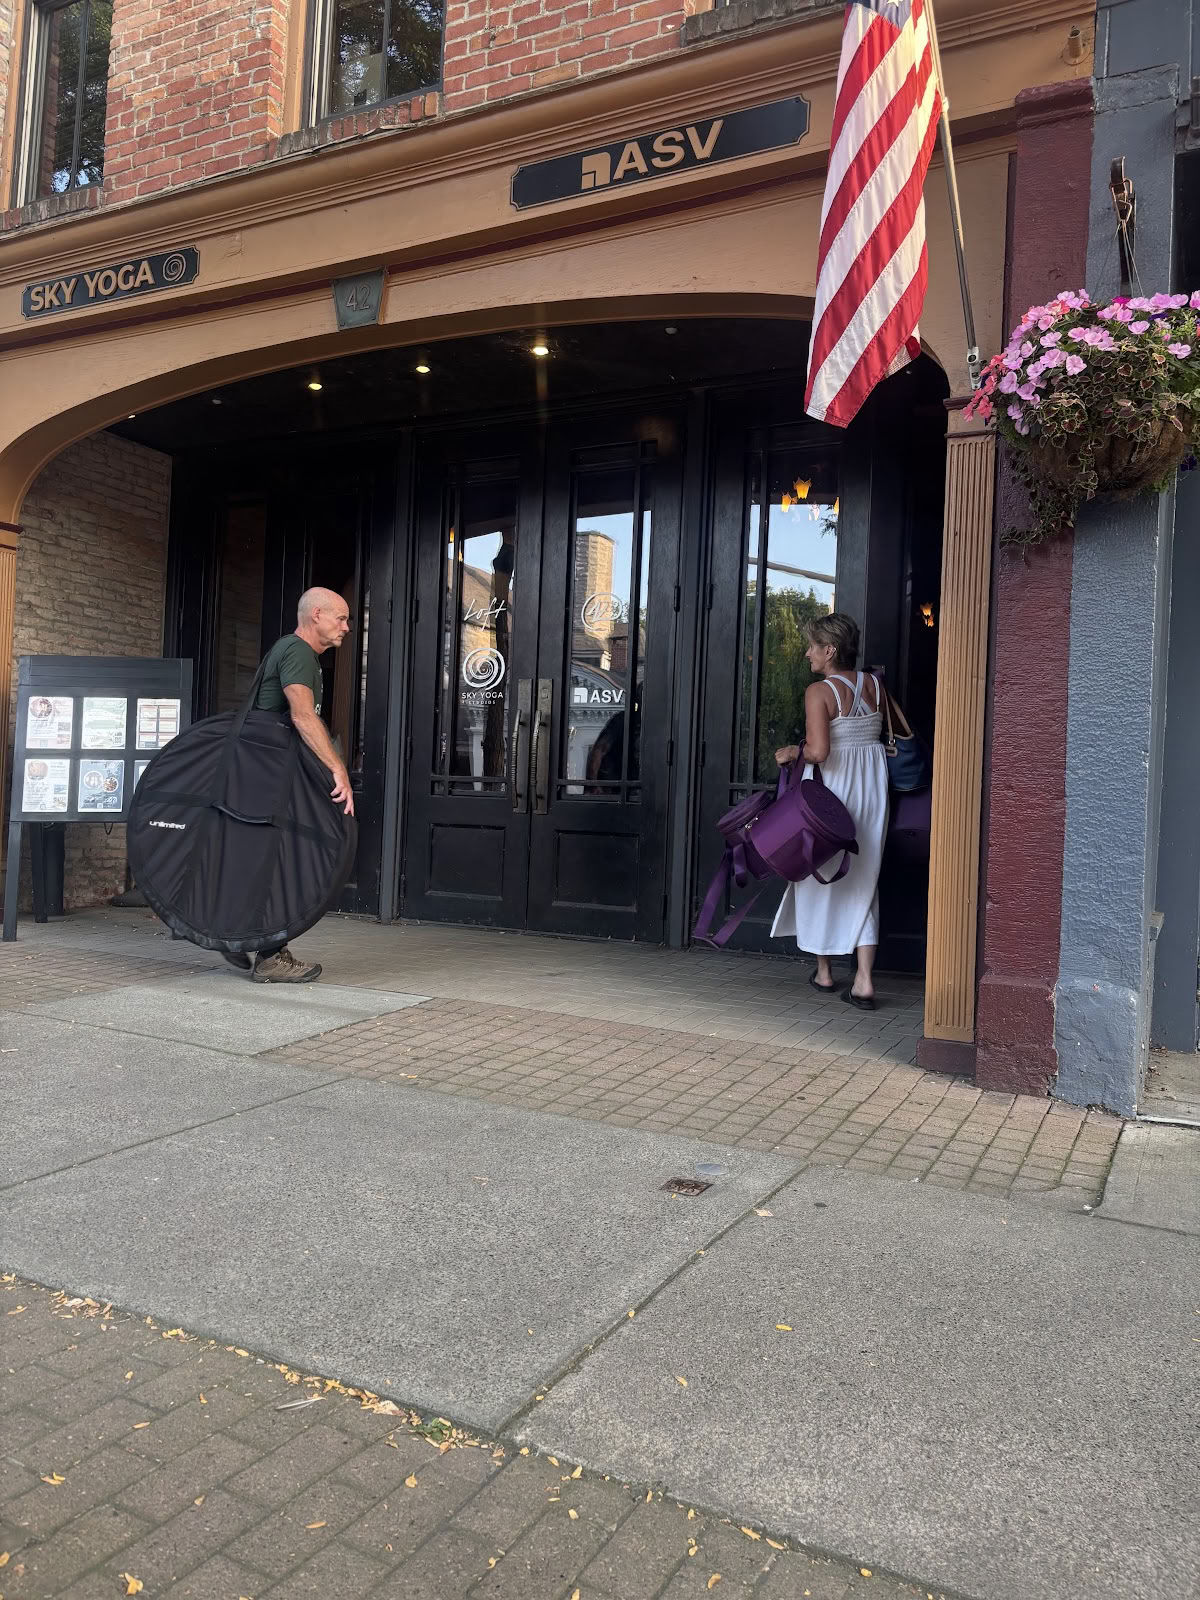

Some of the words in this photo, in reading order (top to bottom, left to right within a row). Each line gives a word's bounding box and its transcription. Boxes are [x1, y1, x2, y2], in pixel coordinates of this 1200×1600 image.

[613, 119, 724, 181] ASV
[31, 277, 78, 311] SKY
[84, 261, 155, 298] YOGA
[346, 284, 371, 311] 42
[463, 597, 507, 632] Loft
[461, 691, 477, 699] SKY
[480, 691, 504, 699] YOGA
[589, 689, 624, 703] ASV
